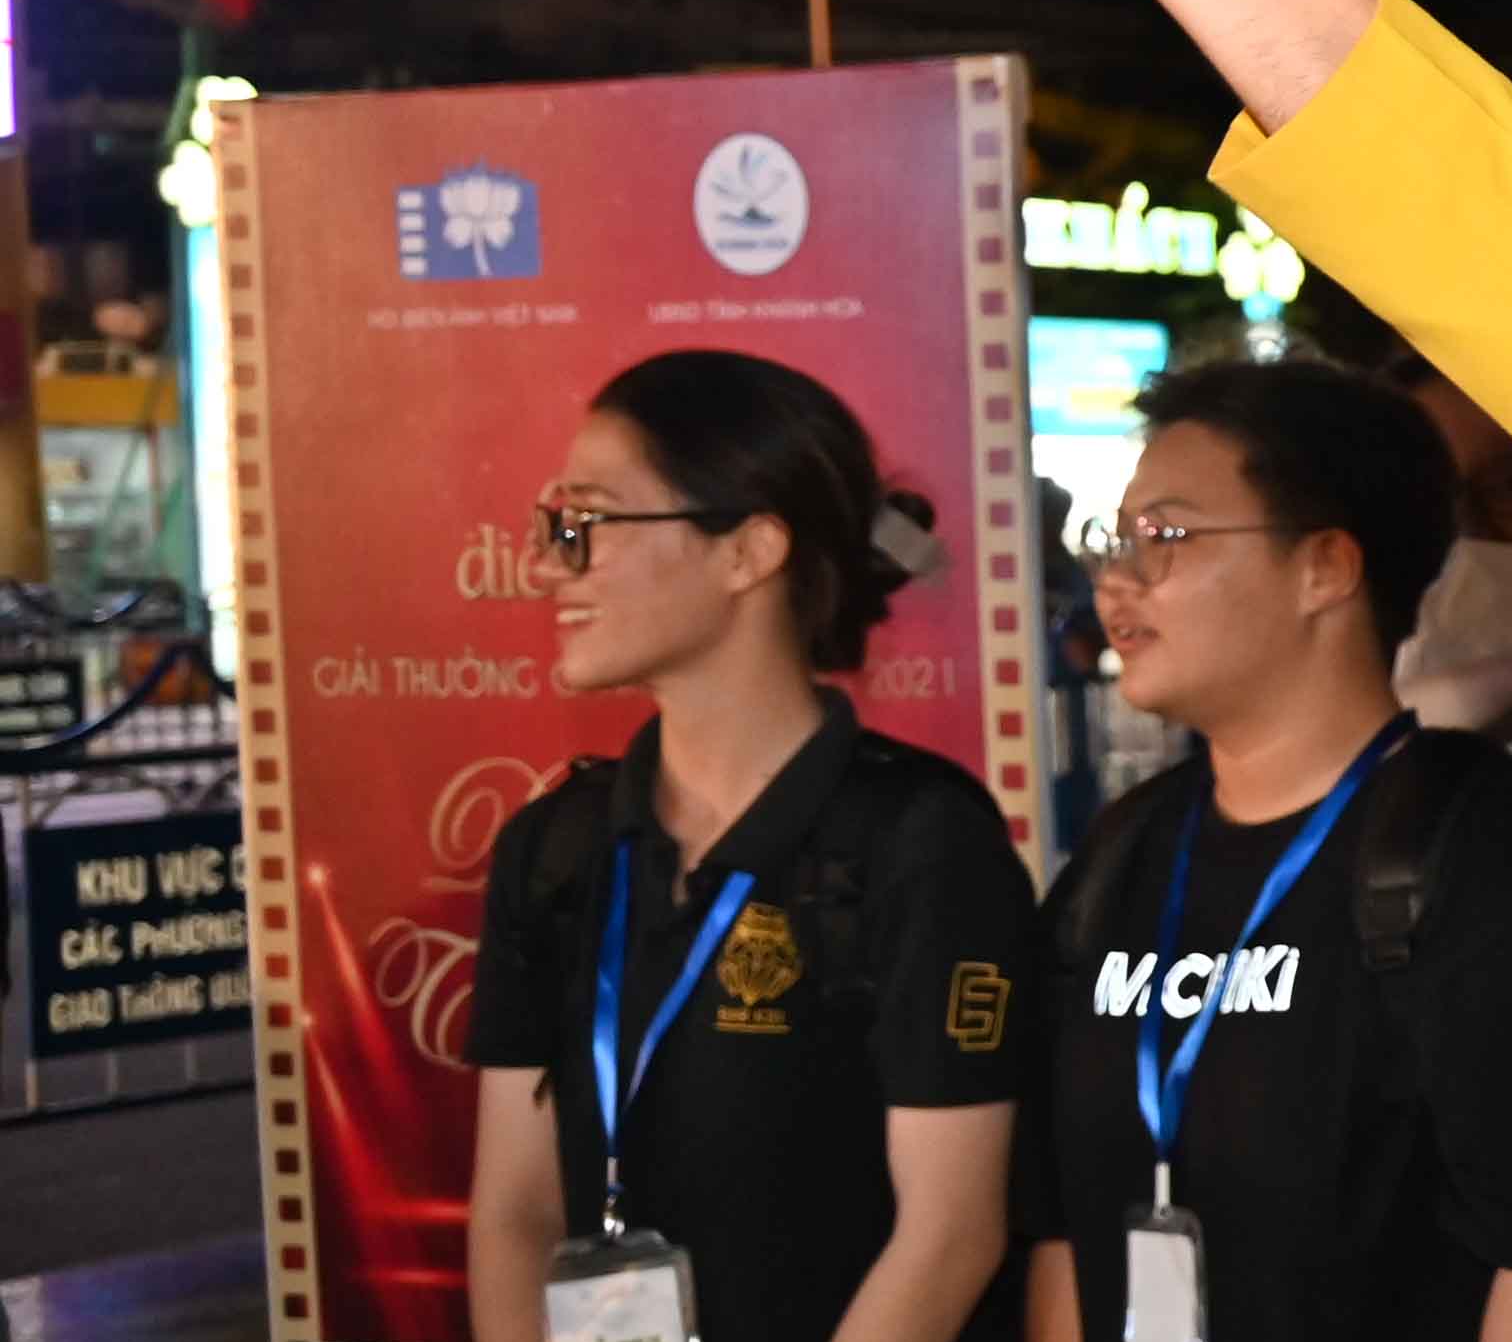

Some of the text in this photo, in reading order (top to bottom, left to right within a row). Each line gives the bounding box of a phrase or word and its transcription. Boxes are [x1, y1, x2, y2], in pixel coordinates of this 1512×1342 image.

[312, 642, 380, 698] GIẢI
[391, 643, 539, 699] THƯỞNG
[77, 855, 147, 905] KHU
[156, 843, 224, 903] VỰC
[60, 917, 123, 971] CÁC
[48, 987, 112, 1033] GIAO
